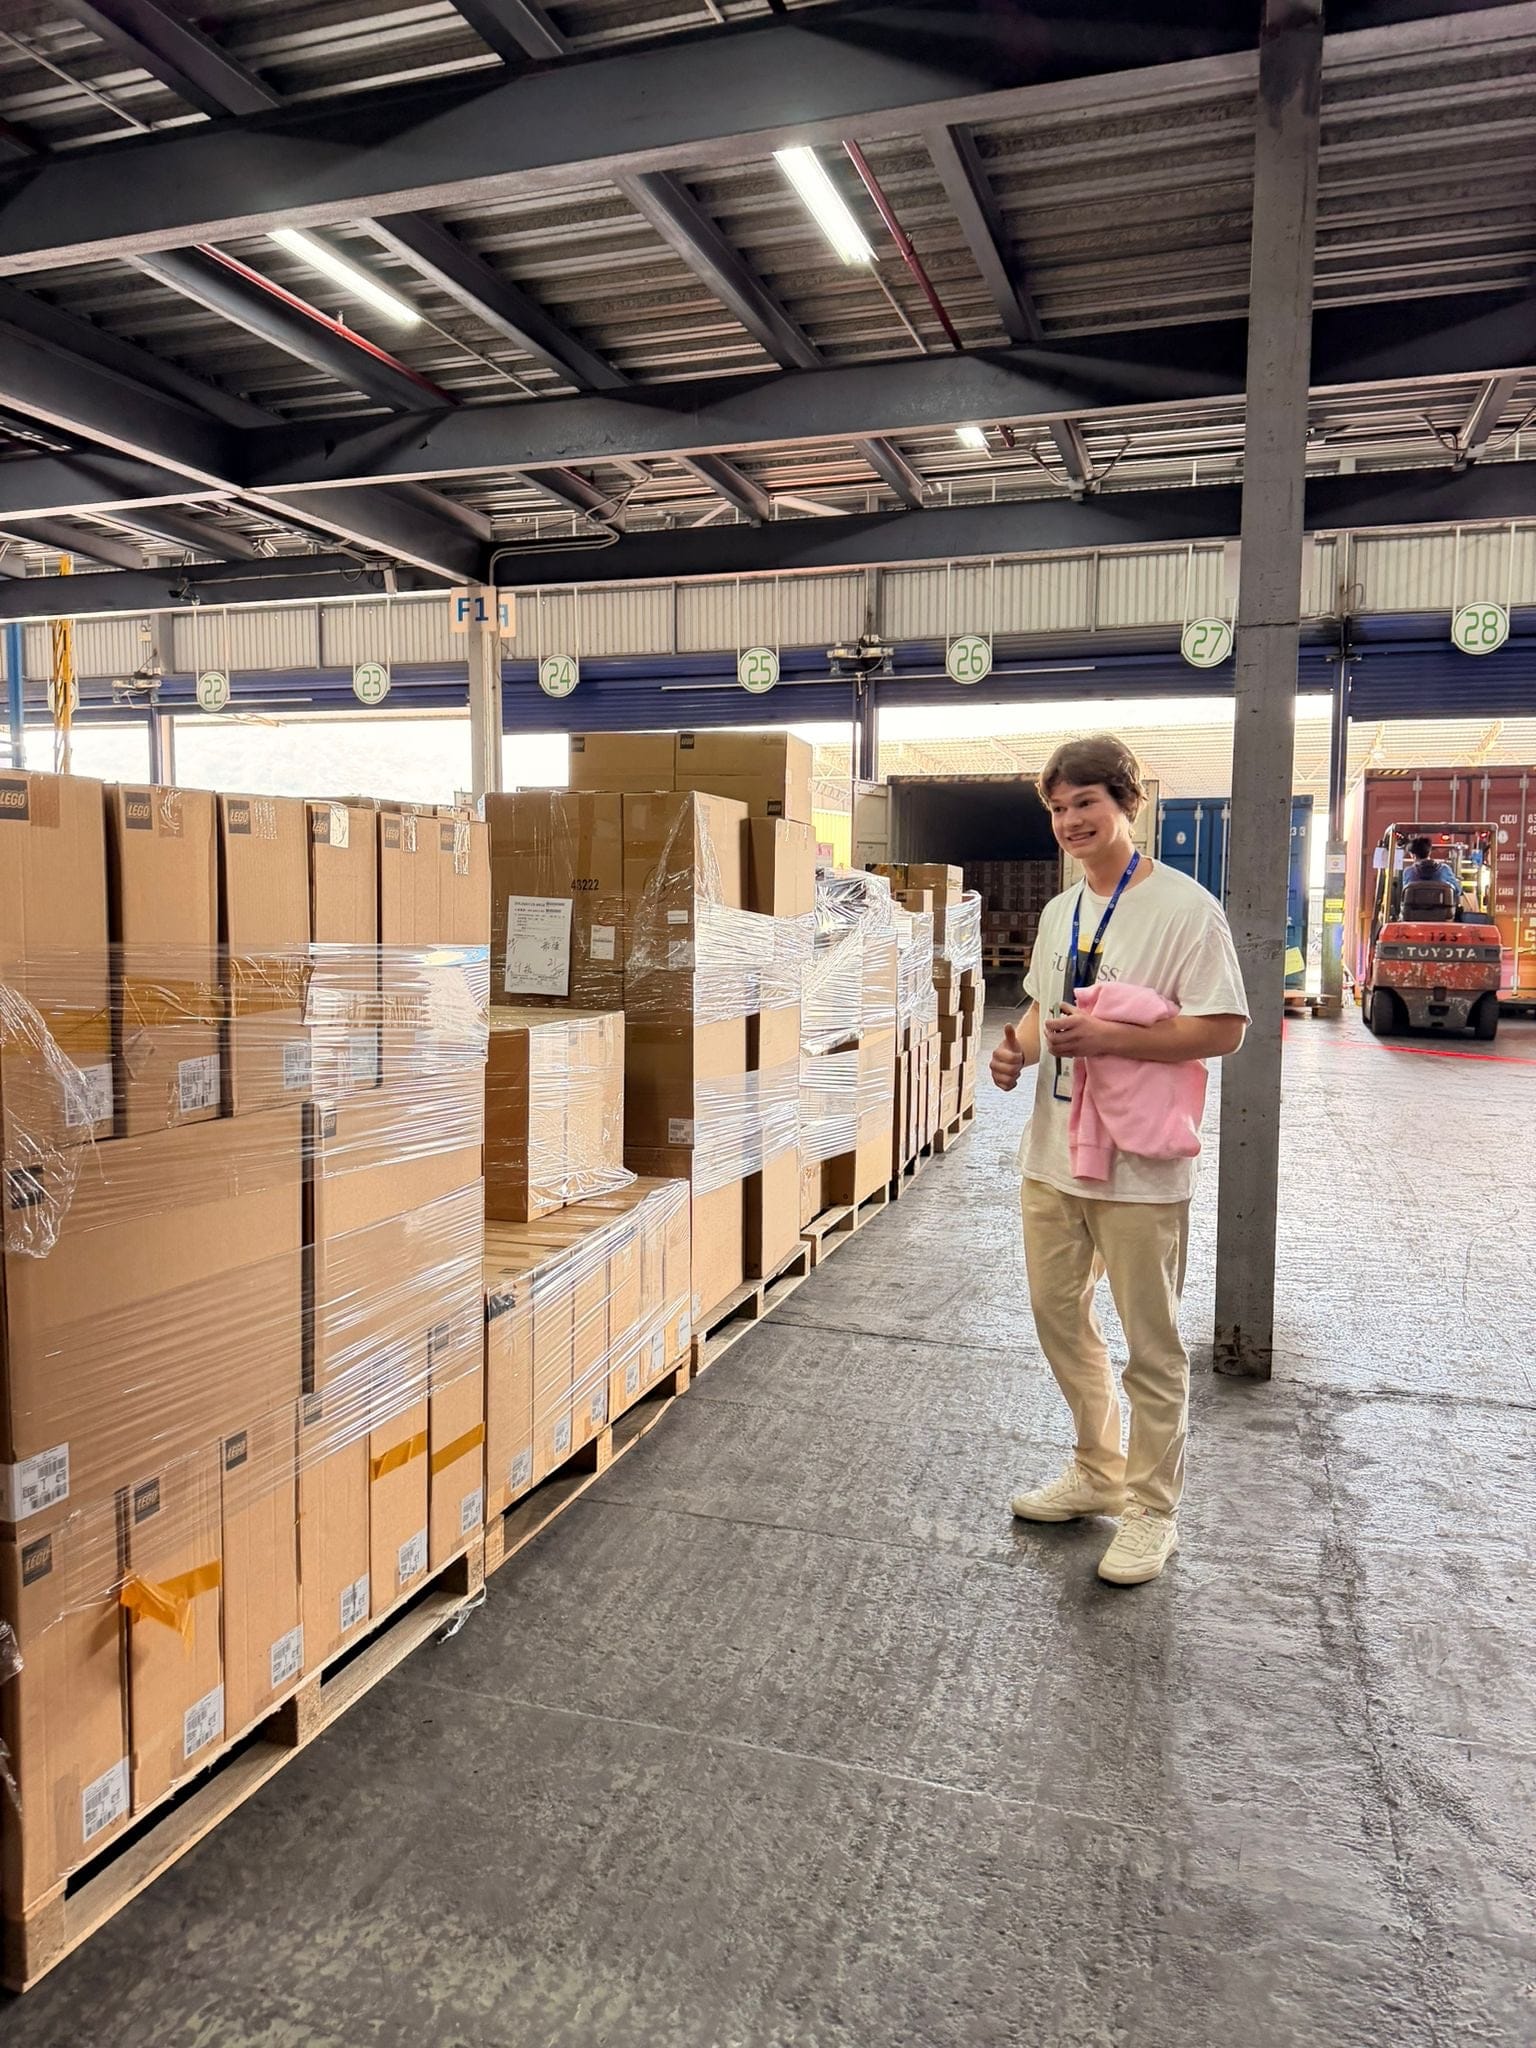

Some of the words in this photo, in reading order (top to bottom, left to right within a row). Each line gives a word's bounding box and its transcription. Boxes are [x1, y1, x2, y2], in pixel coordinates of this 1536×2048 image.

[458, 597, 489, 621] F1
[1464, 612, 1498, 645] 28
[1191, 626, 1224, 659] 27
[748, 655, 771, 685] 25
[957, 643, 984, 675] 26
[362, 670, 381, 697] 23
[548, 664, 571, 690] 24
[204, 679, 222, 705] 22
[0, 791, 25, 807] LEGO
[128, 804, 149, 818] LEGO
[230, 811, 249, 823] LEGO
[137, 1490, 159, 1511] LEGO
[25, 1551, 50, 1571] LEGO
